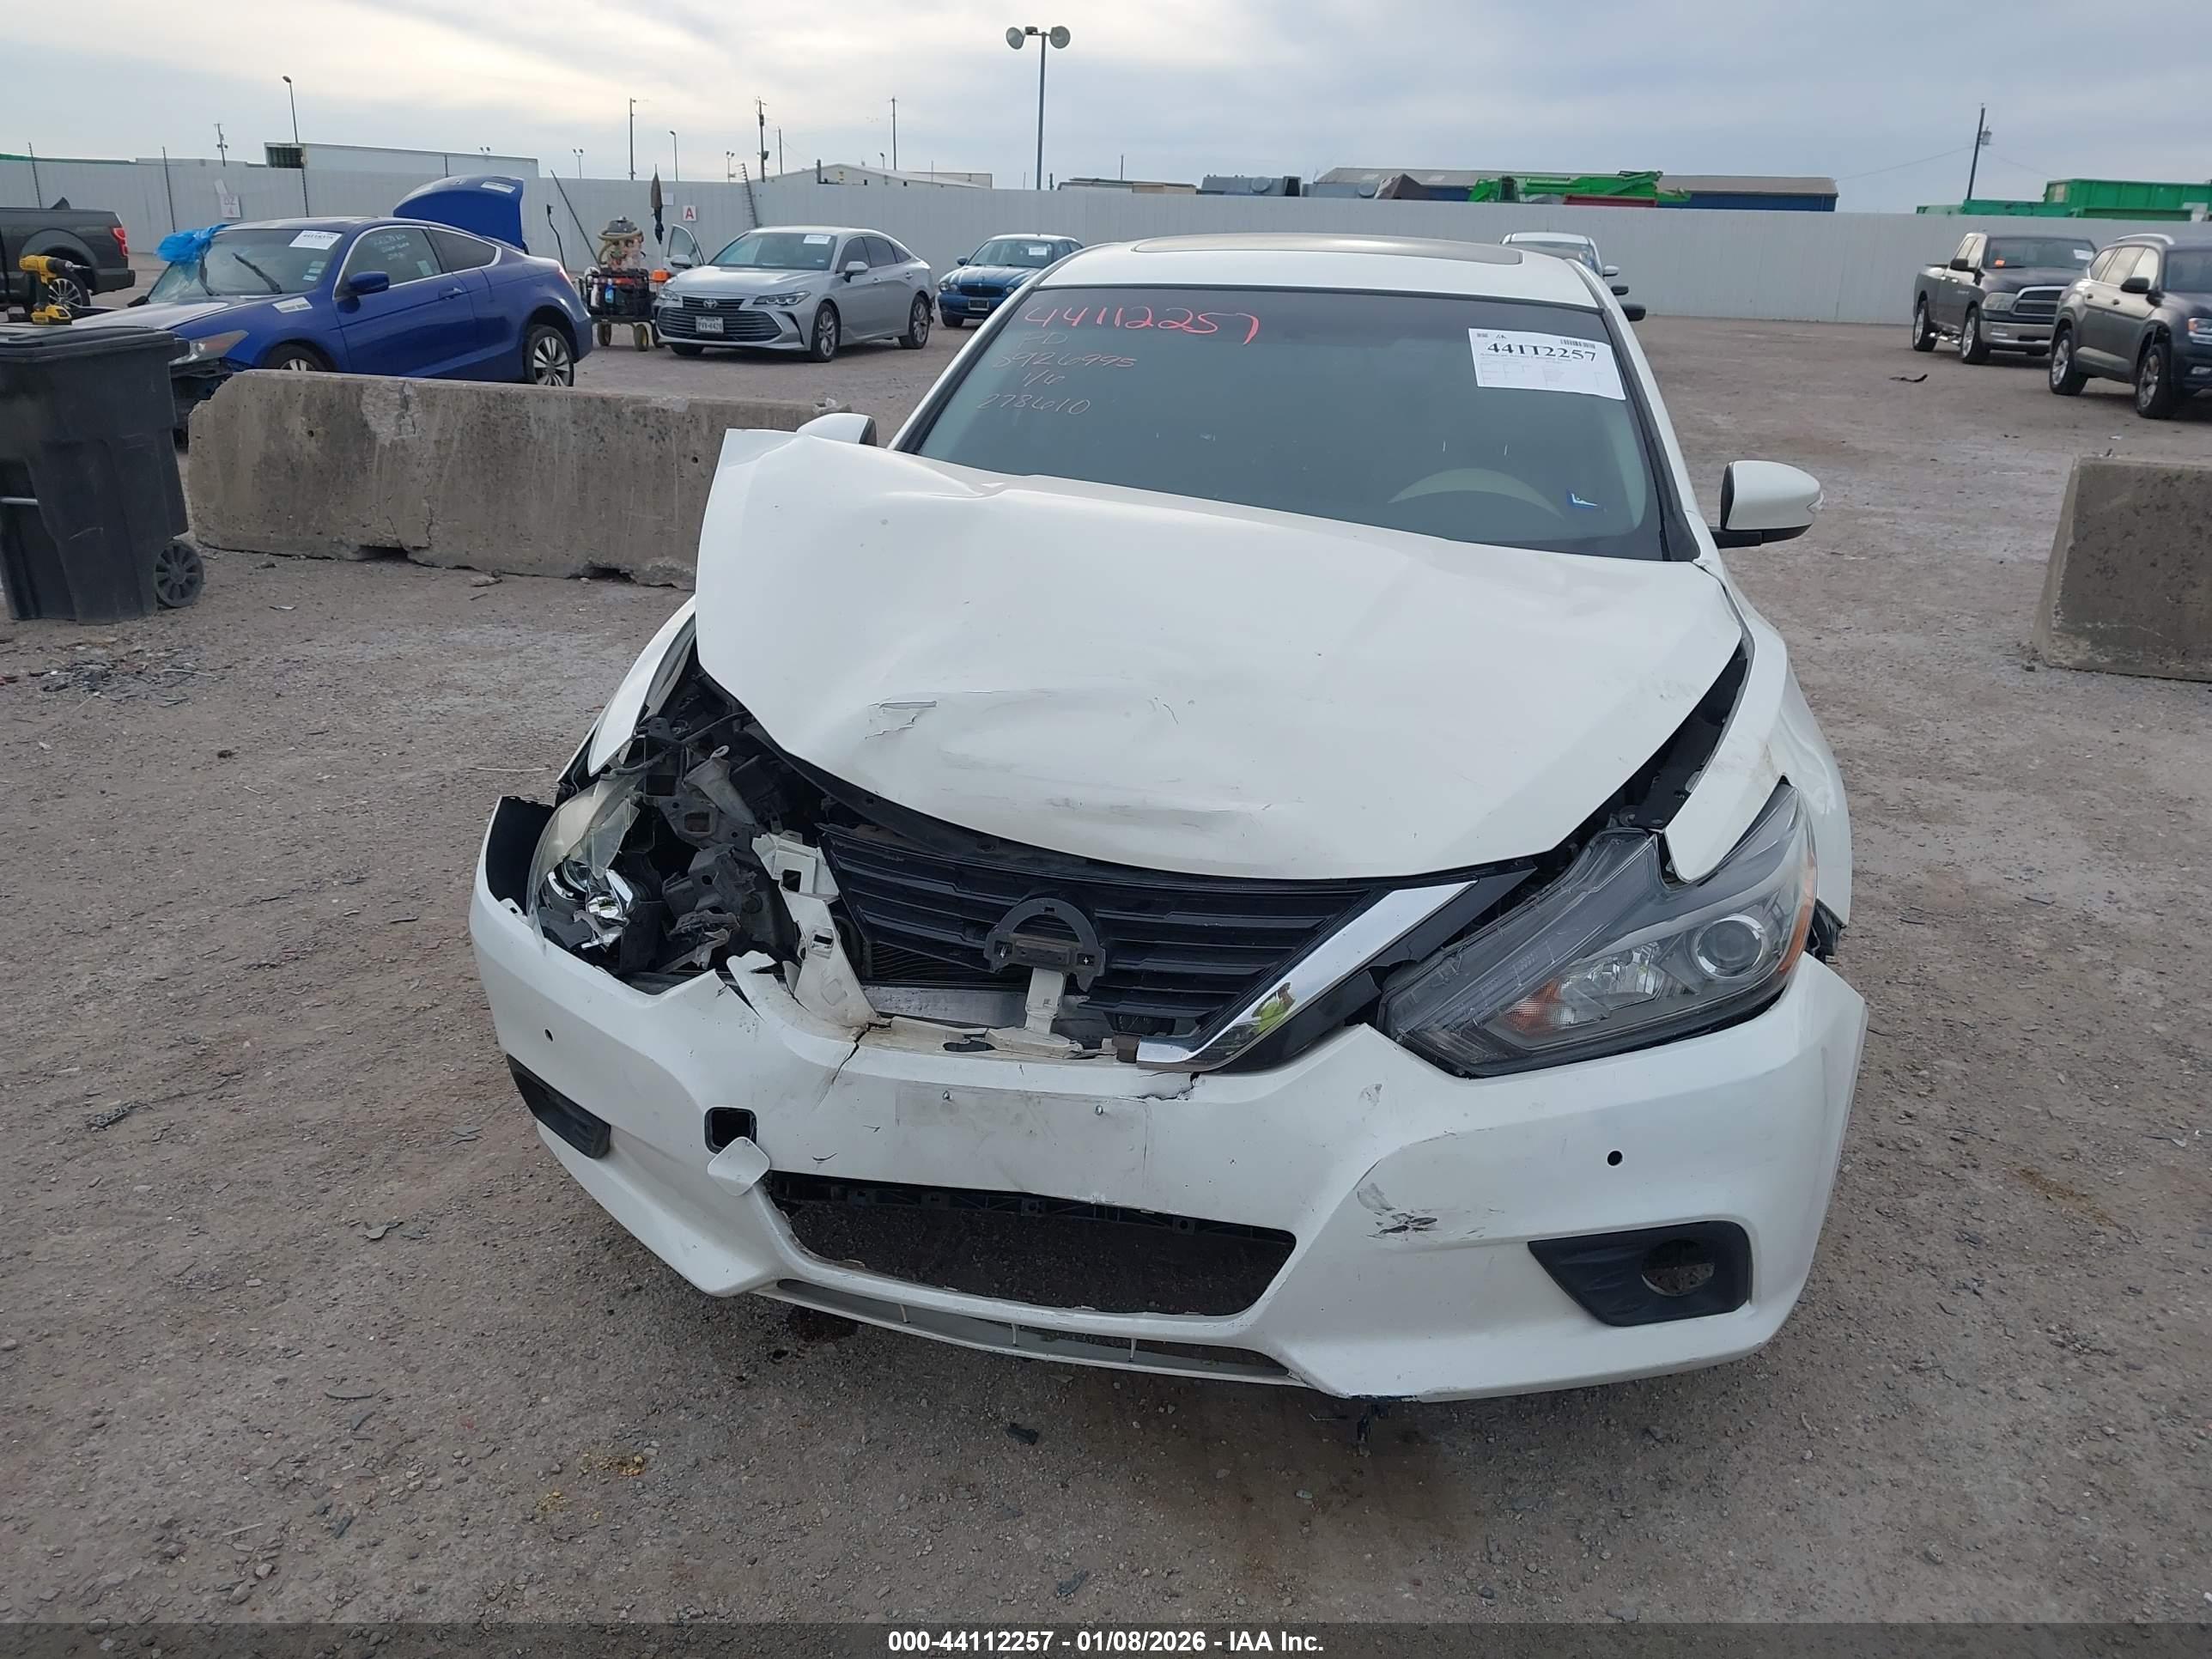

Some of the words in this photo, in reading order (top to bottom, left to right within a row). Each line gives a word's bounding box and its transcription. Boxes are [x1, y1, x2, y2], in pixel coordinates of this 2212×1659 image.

[685, 207, 695, 220] A
[1024, 306, 1260, 345] 44112257
[1487, 342, 1597, 362] 44112257
